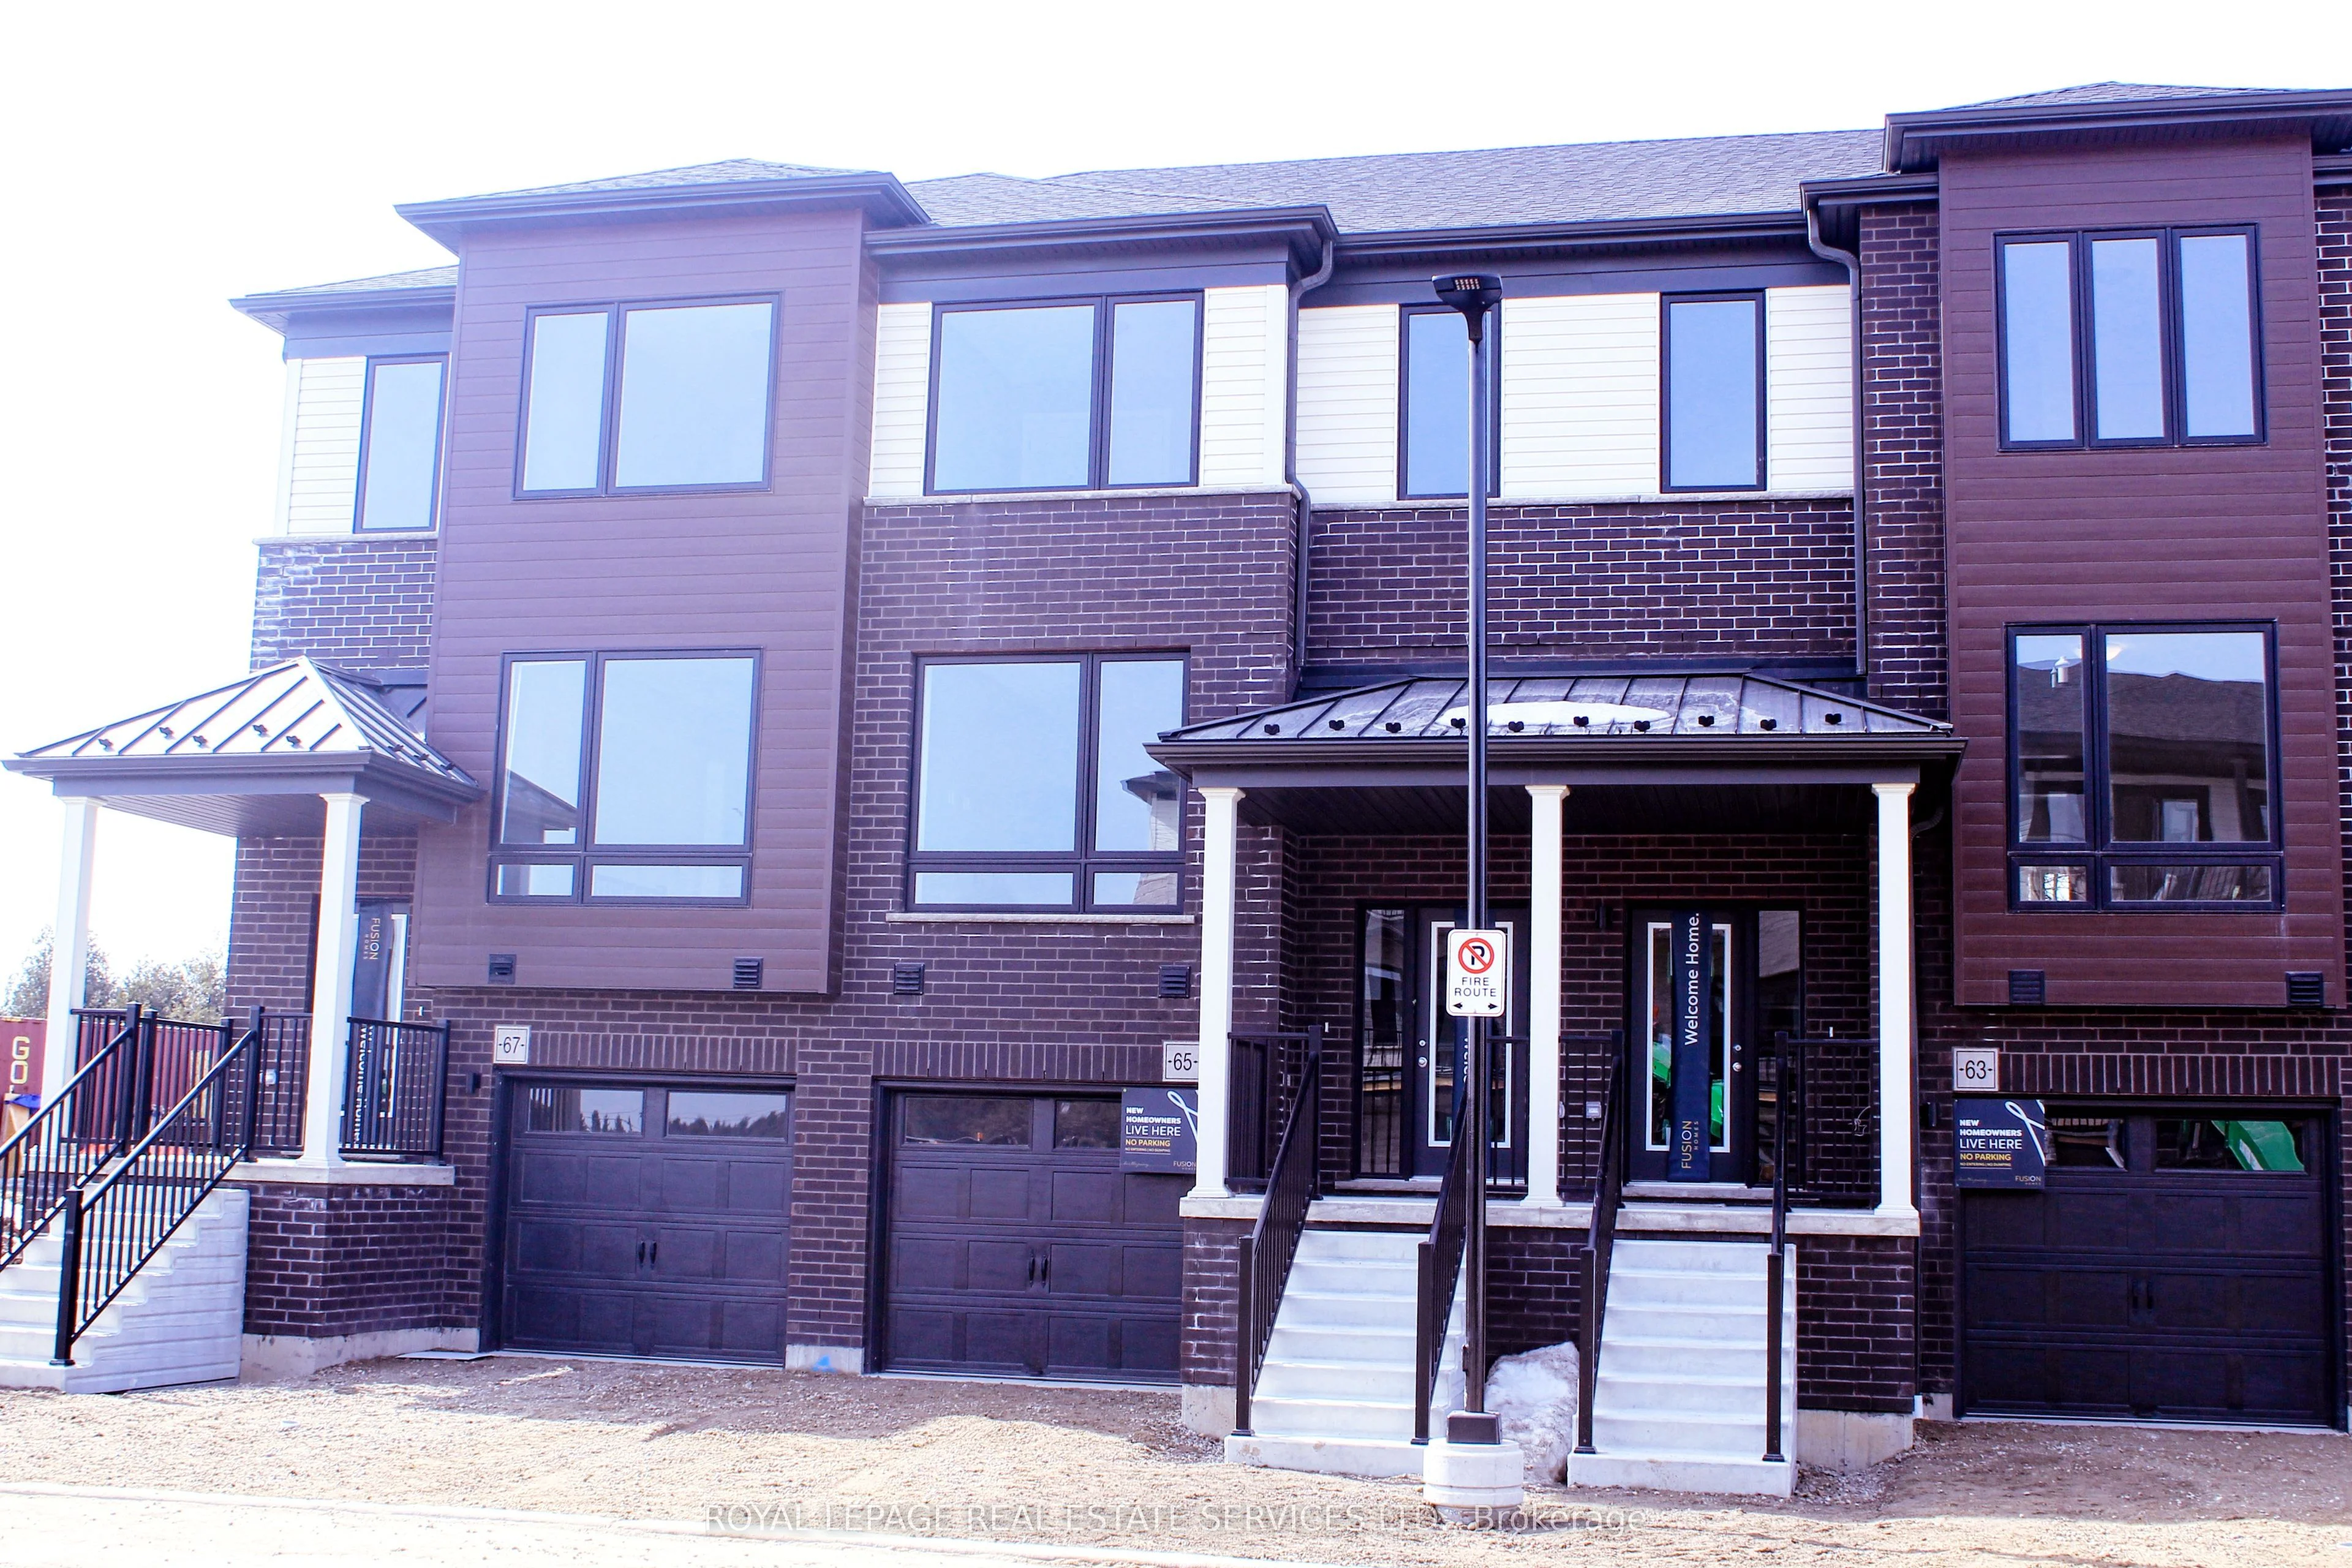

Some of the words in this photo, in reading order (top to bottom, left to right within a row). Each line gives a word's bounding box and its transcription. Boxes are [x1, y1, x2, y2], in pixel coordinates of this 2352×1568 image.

[369, 918, 380, 960] FUSION
[1686, 913, 1700, 965] Home.
[1462, 977, 1490, 986] FIRE
[1455, 987, 1497, 997] ROUTE
[1684, 969, 1698, 1046] Welcome
[1126, 1116, 1181, 1125] HOMEOWNERS
[1126, 1125, 1148, 1135] LIVE
[1152, 1126, 1181, 1136] HERE
[1681, 1120, 1692, 1169] FUSION
[1960, 1138, 1986, 1148] LIVE
[1989, 1139, 2022, 1149] HERE
